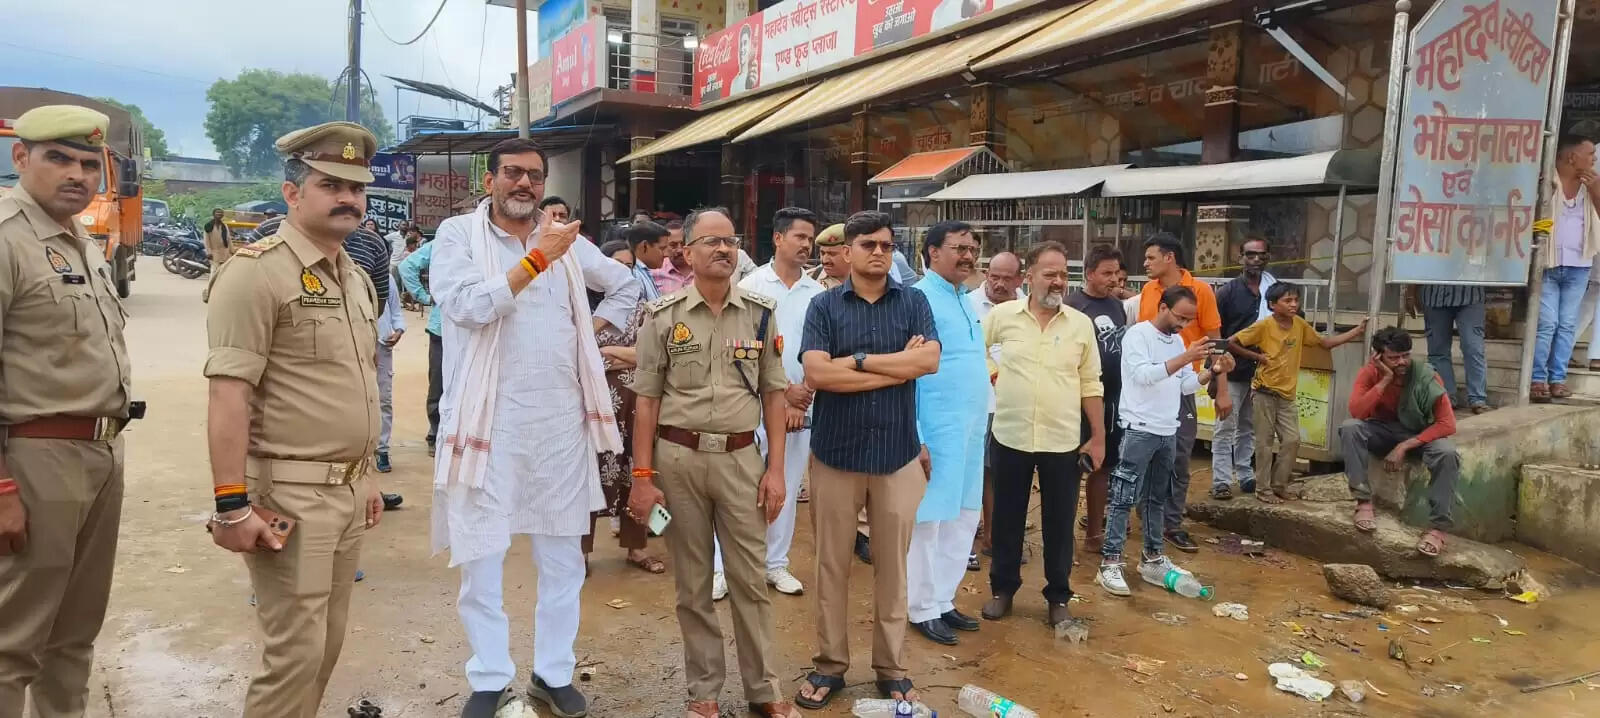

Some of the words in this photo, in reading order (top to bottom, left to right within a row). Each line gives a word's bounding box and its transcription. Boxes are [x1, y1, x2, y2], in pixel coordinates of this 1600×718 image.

[764, 10, 788, 40] महादेव
[1415, 0, 1499, 91] महादेव
[1413, 101, 1542, 163] भोजनालय
[371, 164, 391, 173] mul
